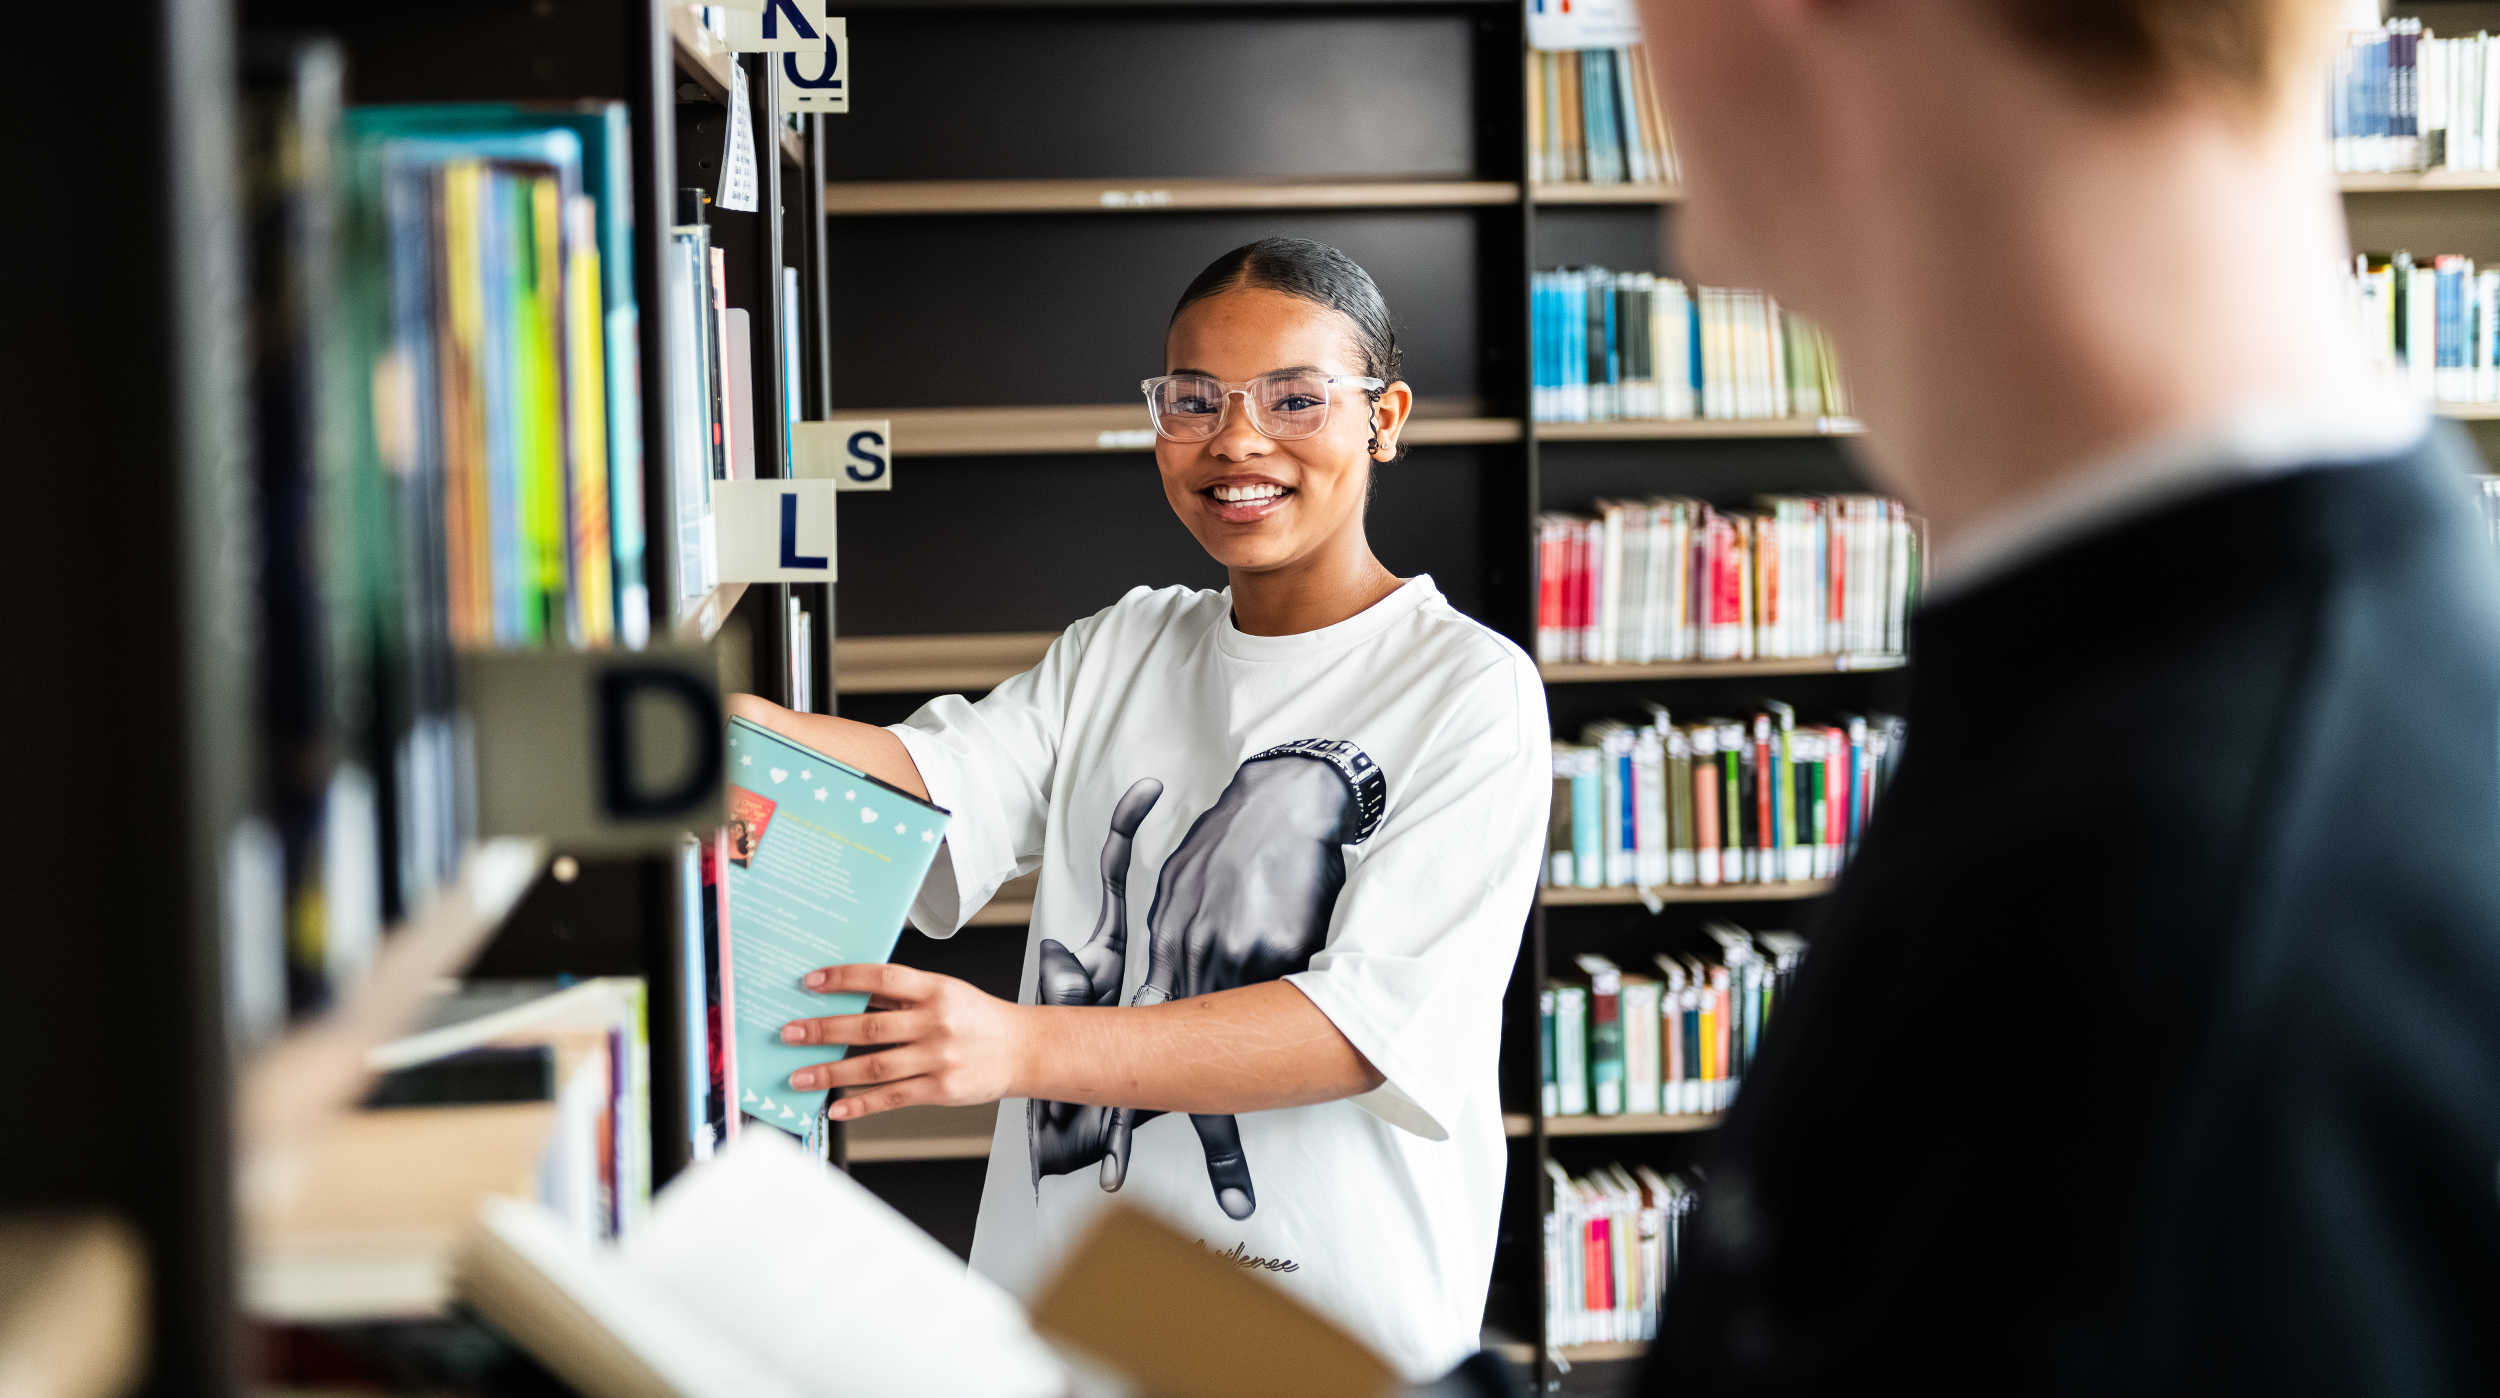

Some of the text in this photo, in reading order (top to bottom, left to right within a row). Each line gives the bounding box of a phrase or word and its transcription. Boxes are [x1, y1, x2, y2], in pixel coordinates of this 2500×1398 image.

[762, 0, 820, 39] K
[783, 33, 842, 89] Q
[846, 430, 886, 482] S
[780, 493, 828, 569] L
[596, 664, 726, 821] D
